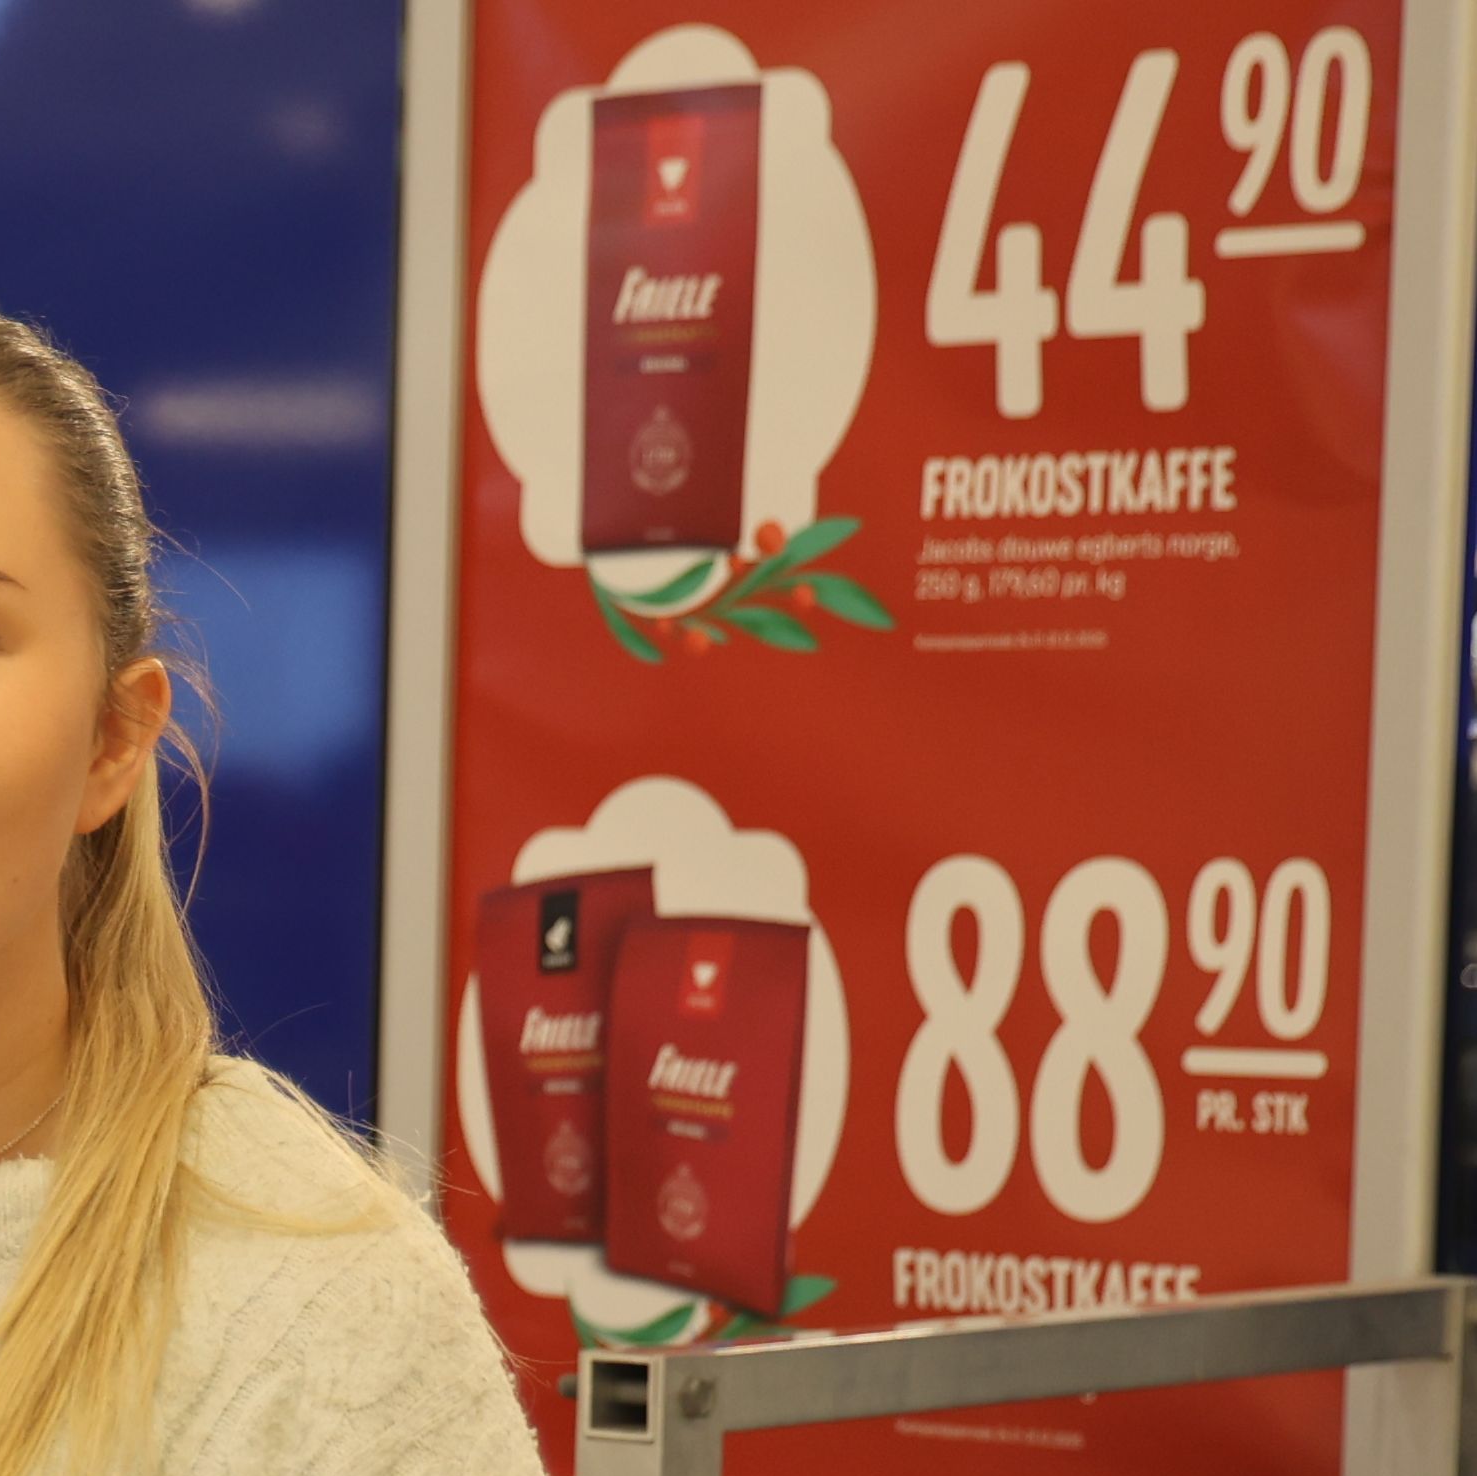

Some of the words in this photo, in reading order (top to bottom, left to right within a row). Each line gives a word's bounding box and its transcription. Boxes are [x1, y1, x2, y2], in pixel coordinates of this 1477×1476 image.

[925, 47, 1206, 420] 44
[1220, 24, 1373, 217] 90
[920, 446, 1237, 521] FROKOSTKAFFE
[1095, 565, 1126, 601] kg
[895, 853, 1170, 1225] 88
[1186, 856, 1332, 1040] 90
[1196, 1089, 1244, 1133] PR.
[1252, 1092, 1309, 1135] STK
[892, 1246, 1202, 1314] FROKOSTKAFFE
